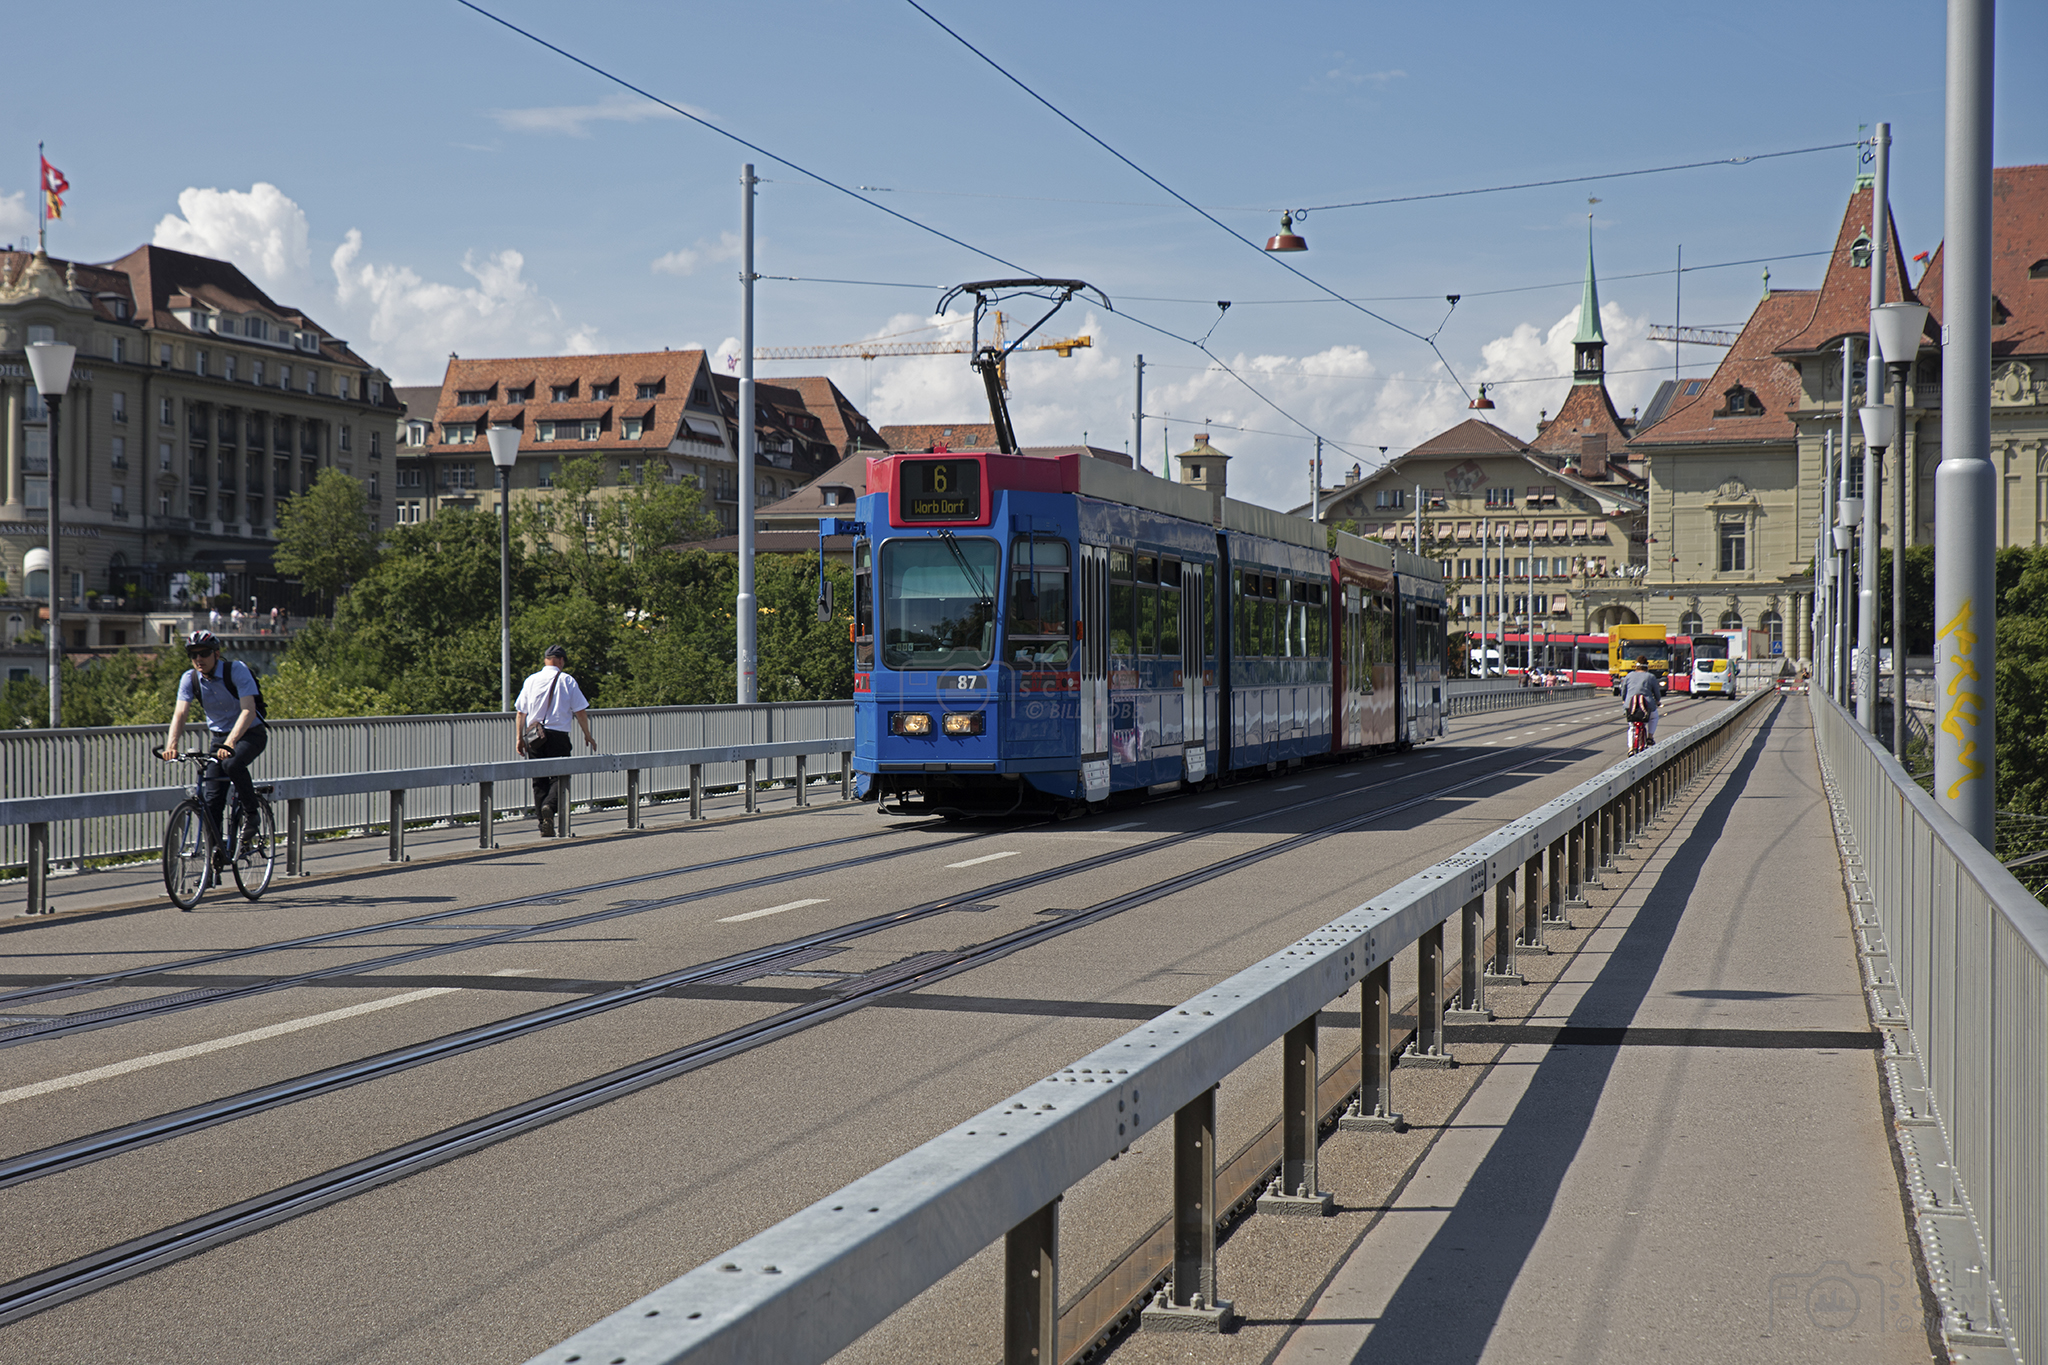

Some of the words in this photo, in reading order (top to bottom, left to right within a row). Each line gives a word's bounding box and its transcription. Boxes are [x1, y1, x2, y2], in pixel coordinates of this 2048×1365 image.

[934, 465, 947, 493] 6
[914, 500, 940, 514] Worb
[941, 500, 964, 513] Dorf
[957, 675, 977, 690] 87
